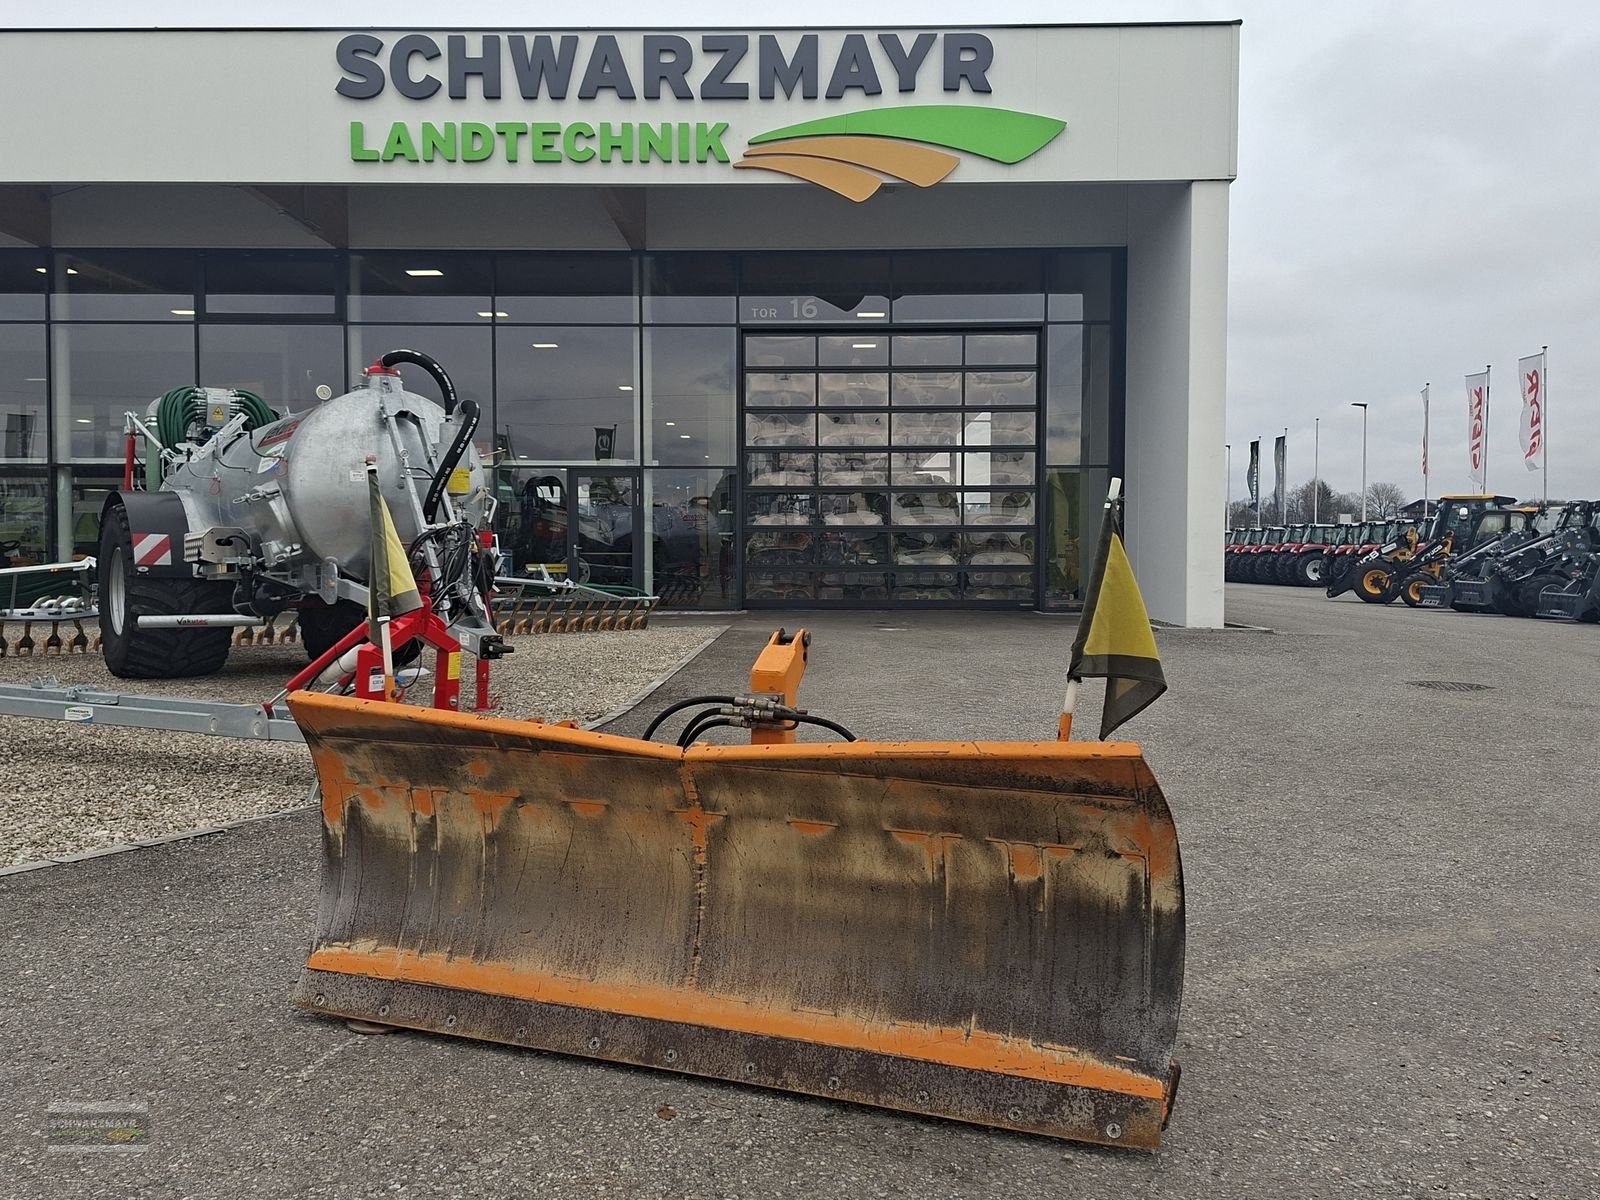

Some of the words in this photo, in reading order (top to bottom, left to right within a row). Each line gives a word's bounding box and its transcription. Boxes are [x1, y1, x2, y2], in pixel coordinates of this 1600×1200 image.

[335, 32, 994, 101] SCHWARZMAYR
[350, 121, 731, 164] LANDTECHNIK
[751, 308, 777, 318] TOR
[789, 298, 818, 319] 16
